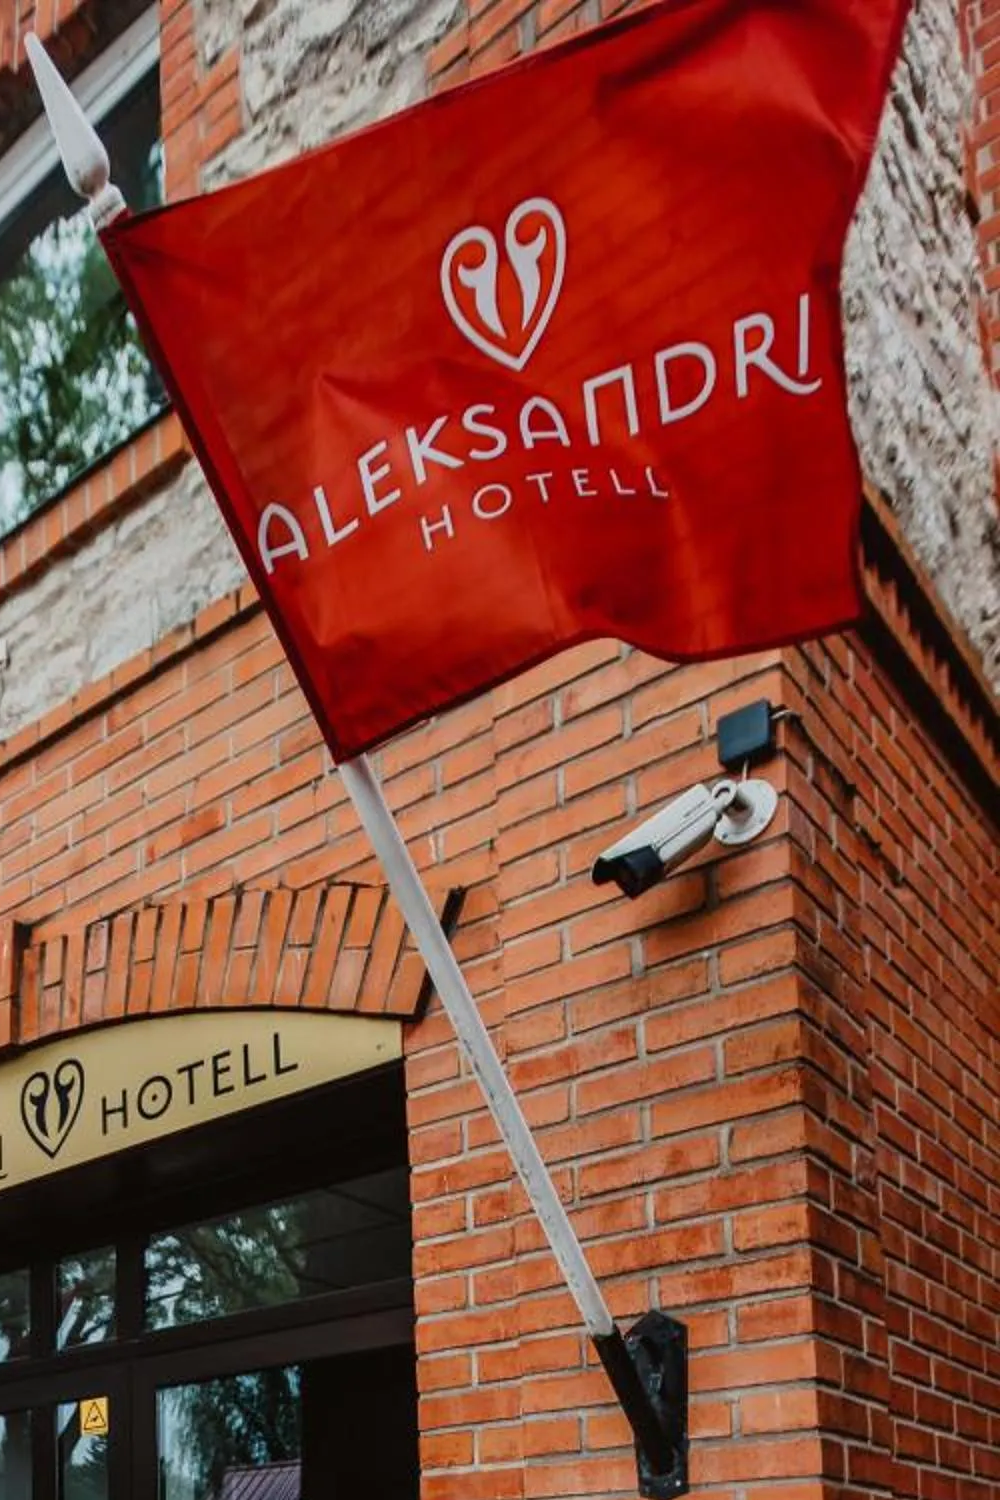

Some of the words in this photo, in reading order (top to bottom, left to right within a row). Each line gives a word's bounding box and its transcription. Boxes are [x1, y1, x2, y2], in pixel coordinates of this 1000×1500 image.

[257, 294, 822, 575] ALEKSANDRI
[420, 466, 669, 551] HOTELL
[101, 1032, 299, 1135] HOTELL
